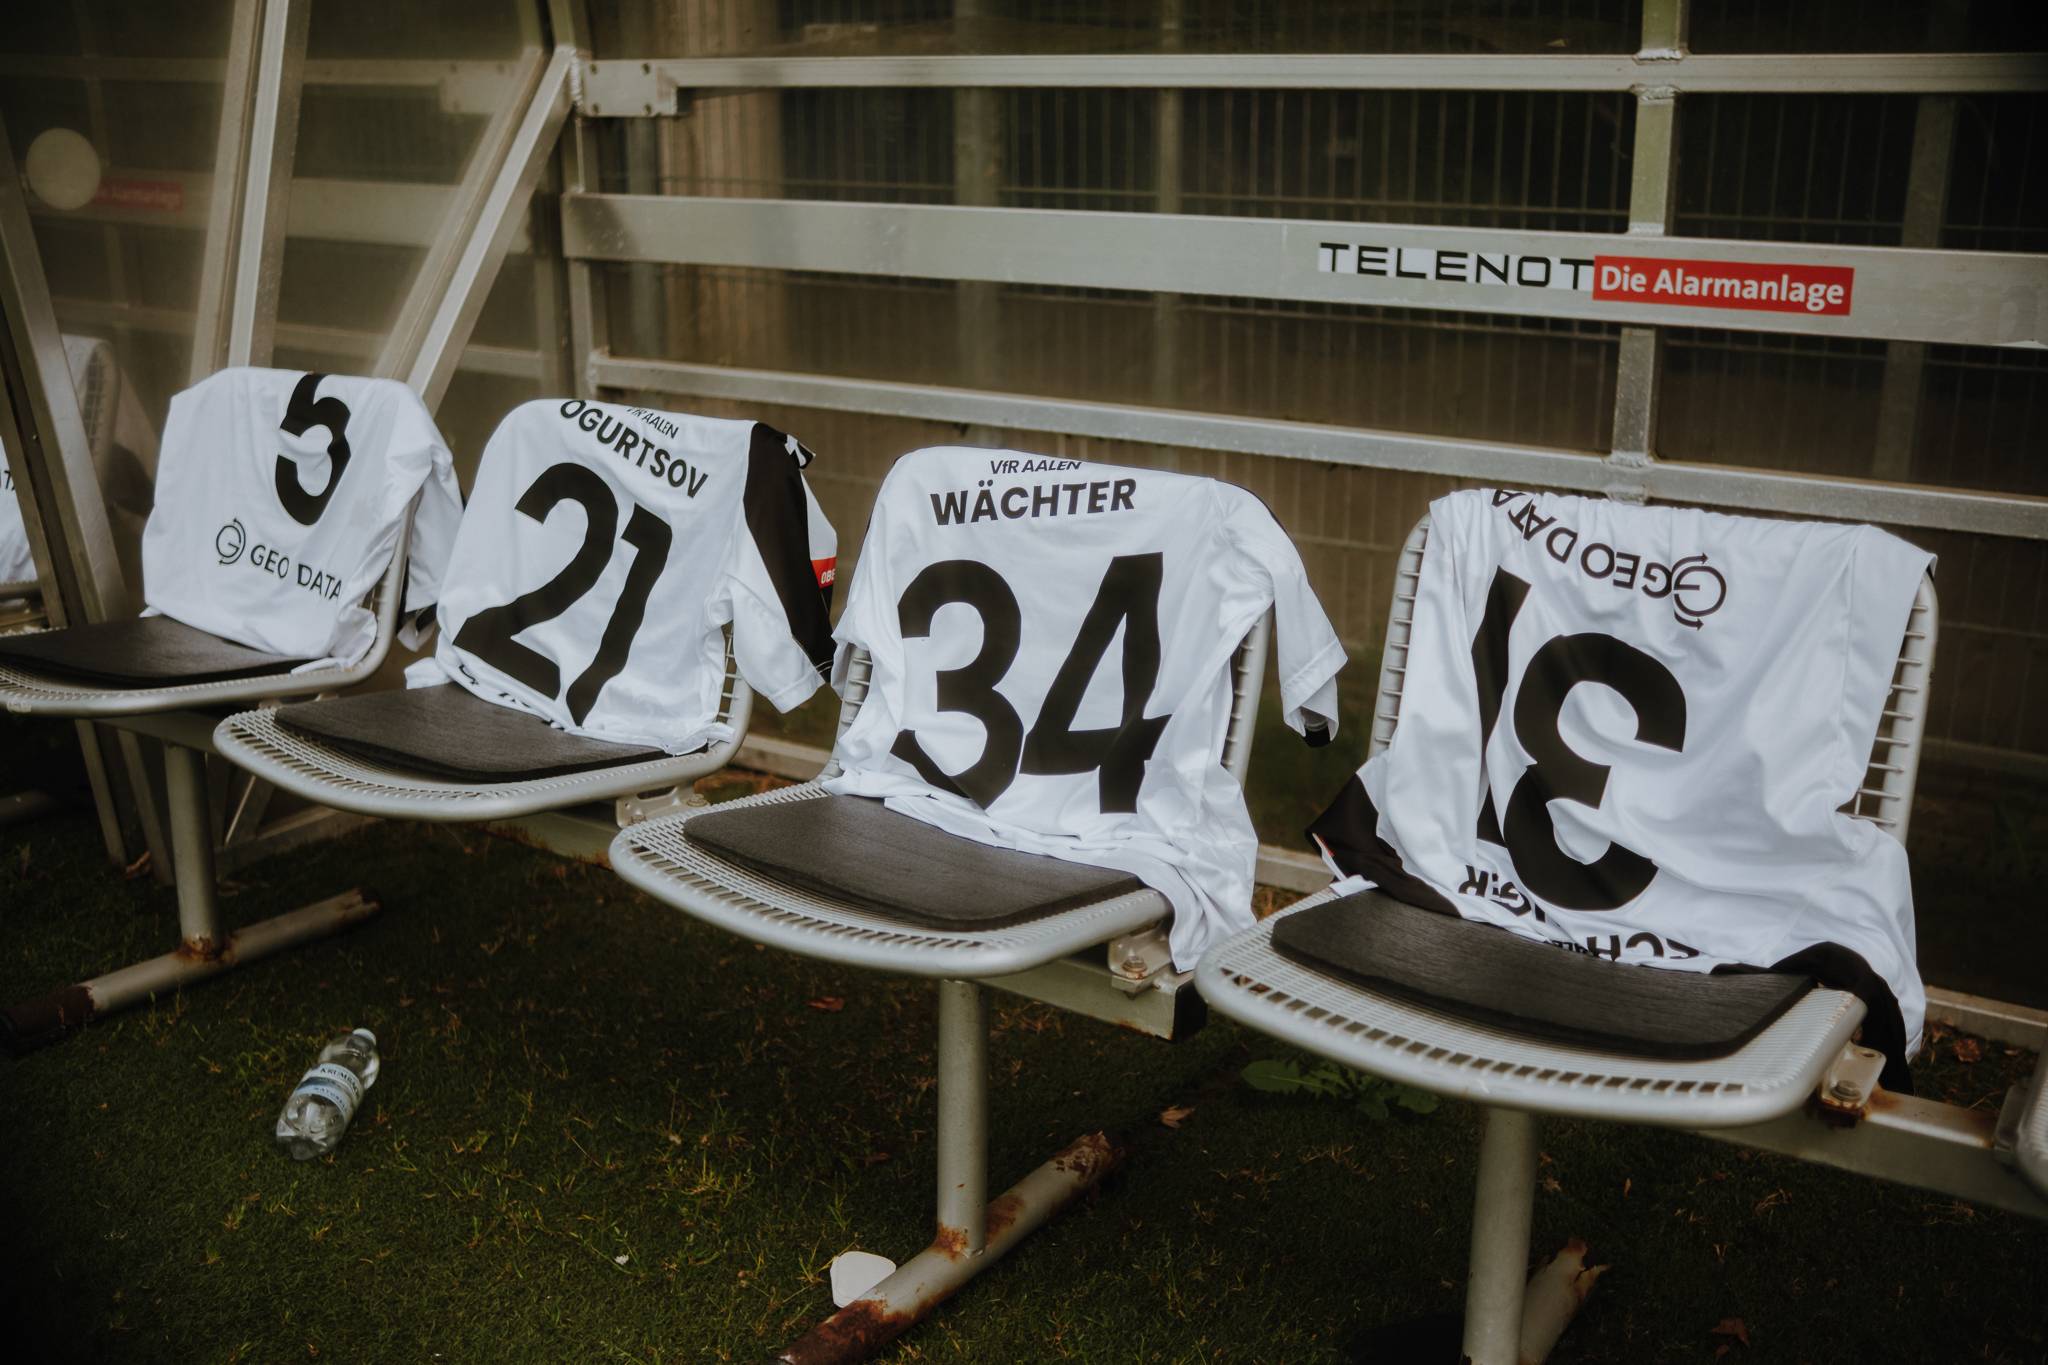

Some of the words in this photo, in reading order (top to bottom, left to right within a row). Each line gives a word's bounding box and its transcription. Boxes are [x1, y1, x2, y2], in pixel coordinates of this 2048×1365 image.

[1319, 242, 1595, 291] TELENOT
[1600, 264, 1649, 293] Die
[1653, 267, 1845, 312] Alarmanlage
[560, 399, 709, 499] OGURTSOV
[990, 459, 1020, 475] VfR
[1021, 459, 1083, 474] AALEN
[929, 478, 1137, 526] WÄCHTER
[250, 544, 290, 579] GEO
[297, 562, 343, 601] DATA
[452, 462, 673, 728] 21
[1580, 543, 1673, 599] GEO
[888, 551, 1173, 814] 34
